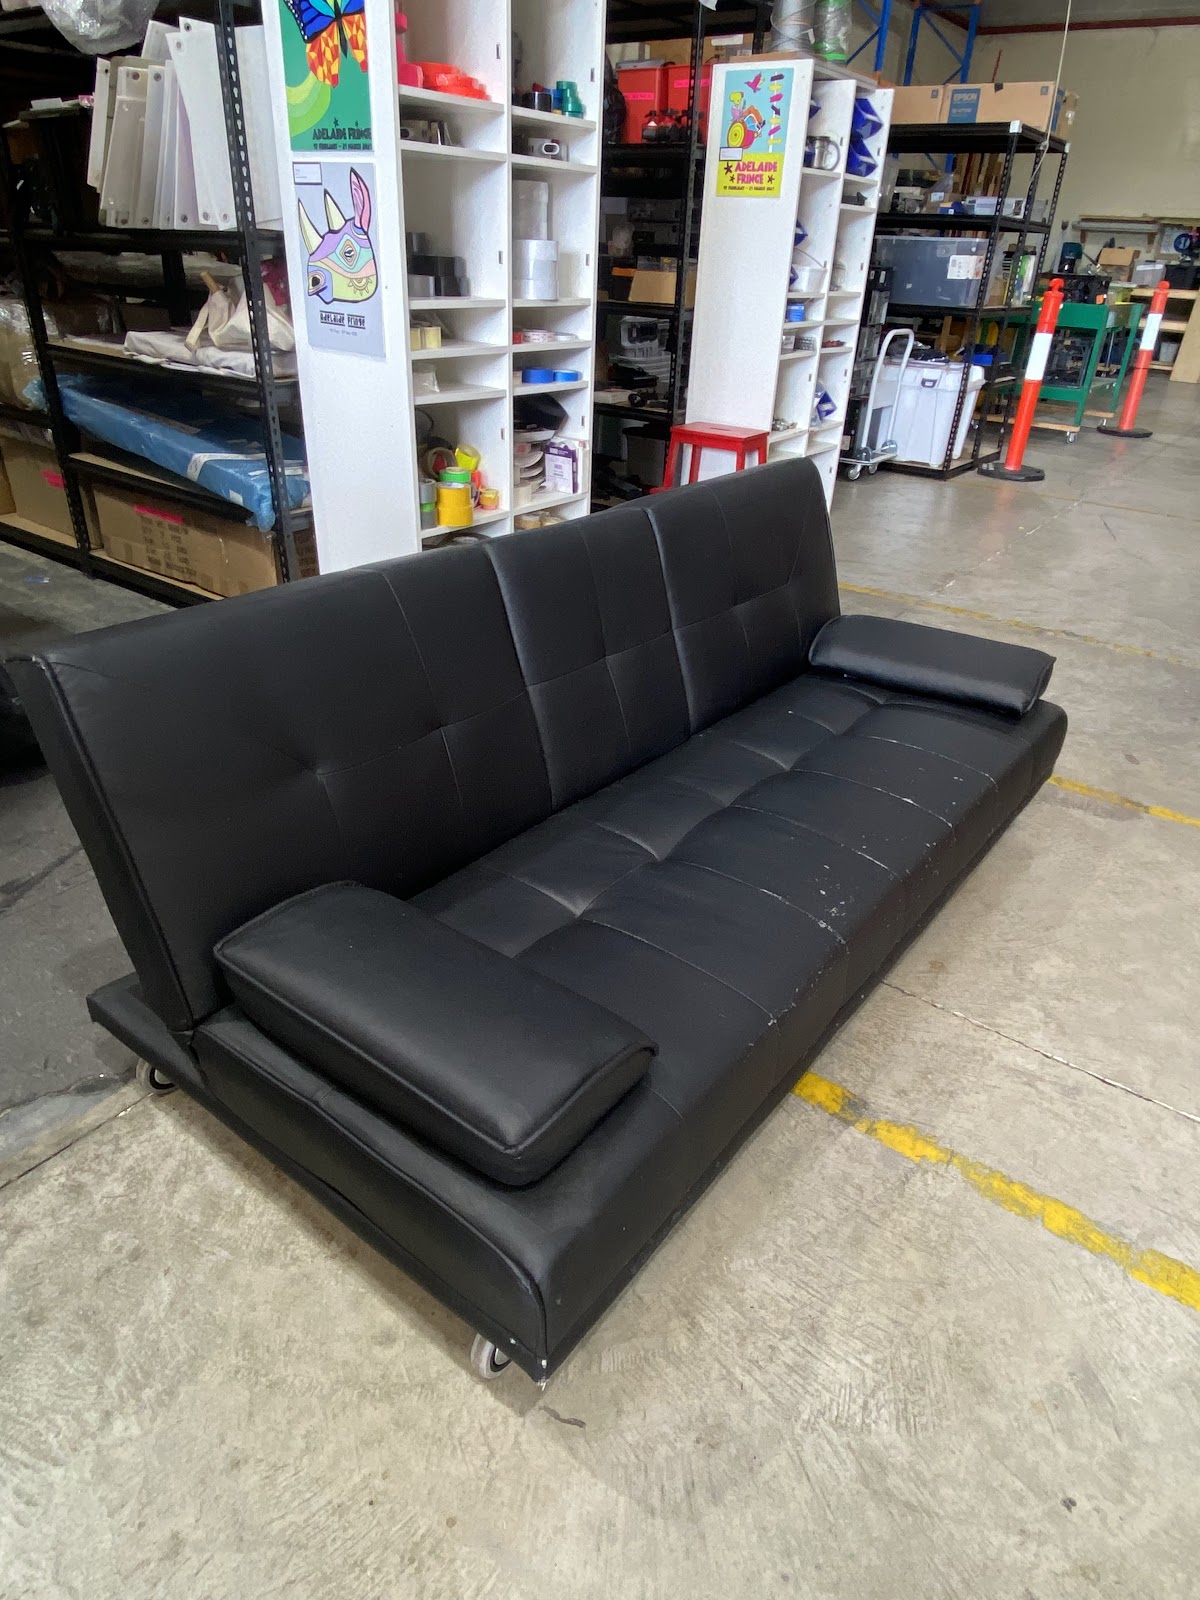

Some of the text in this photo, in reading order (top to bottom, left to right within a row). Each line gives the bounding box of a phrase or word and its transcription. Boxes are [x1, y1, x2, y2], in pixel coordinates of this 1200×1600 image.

[953, 92, 978, 102] EPSON
[313, 127, 372, 140] ADELAIDE FRINGE
[735, 161, 778, 172] ADELAIDE
[736, 173, 764, 184] FRINGE
